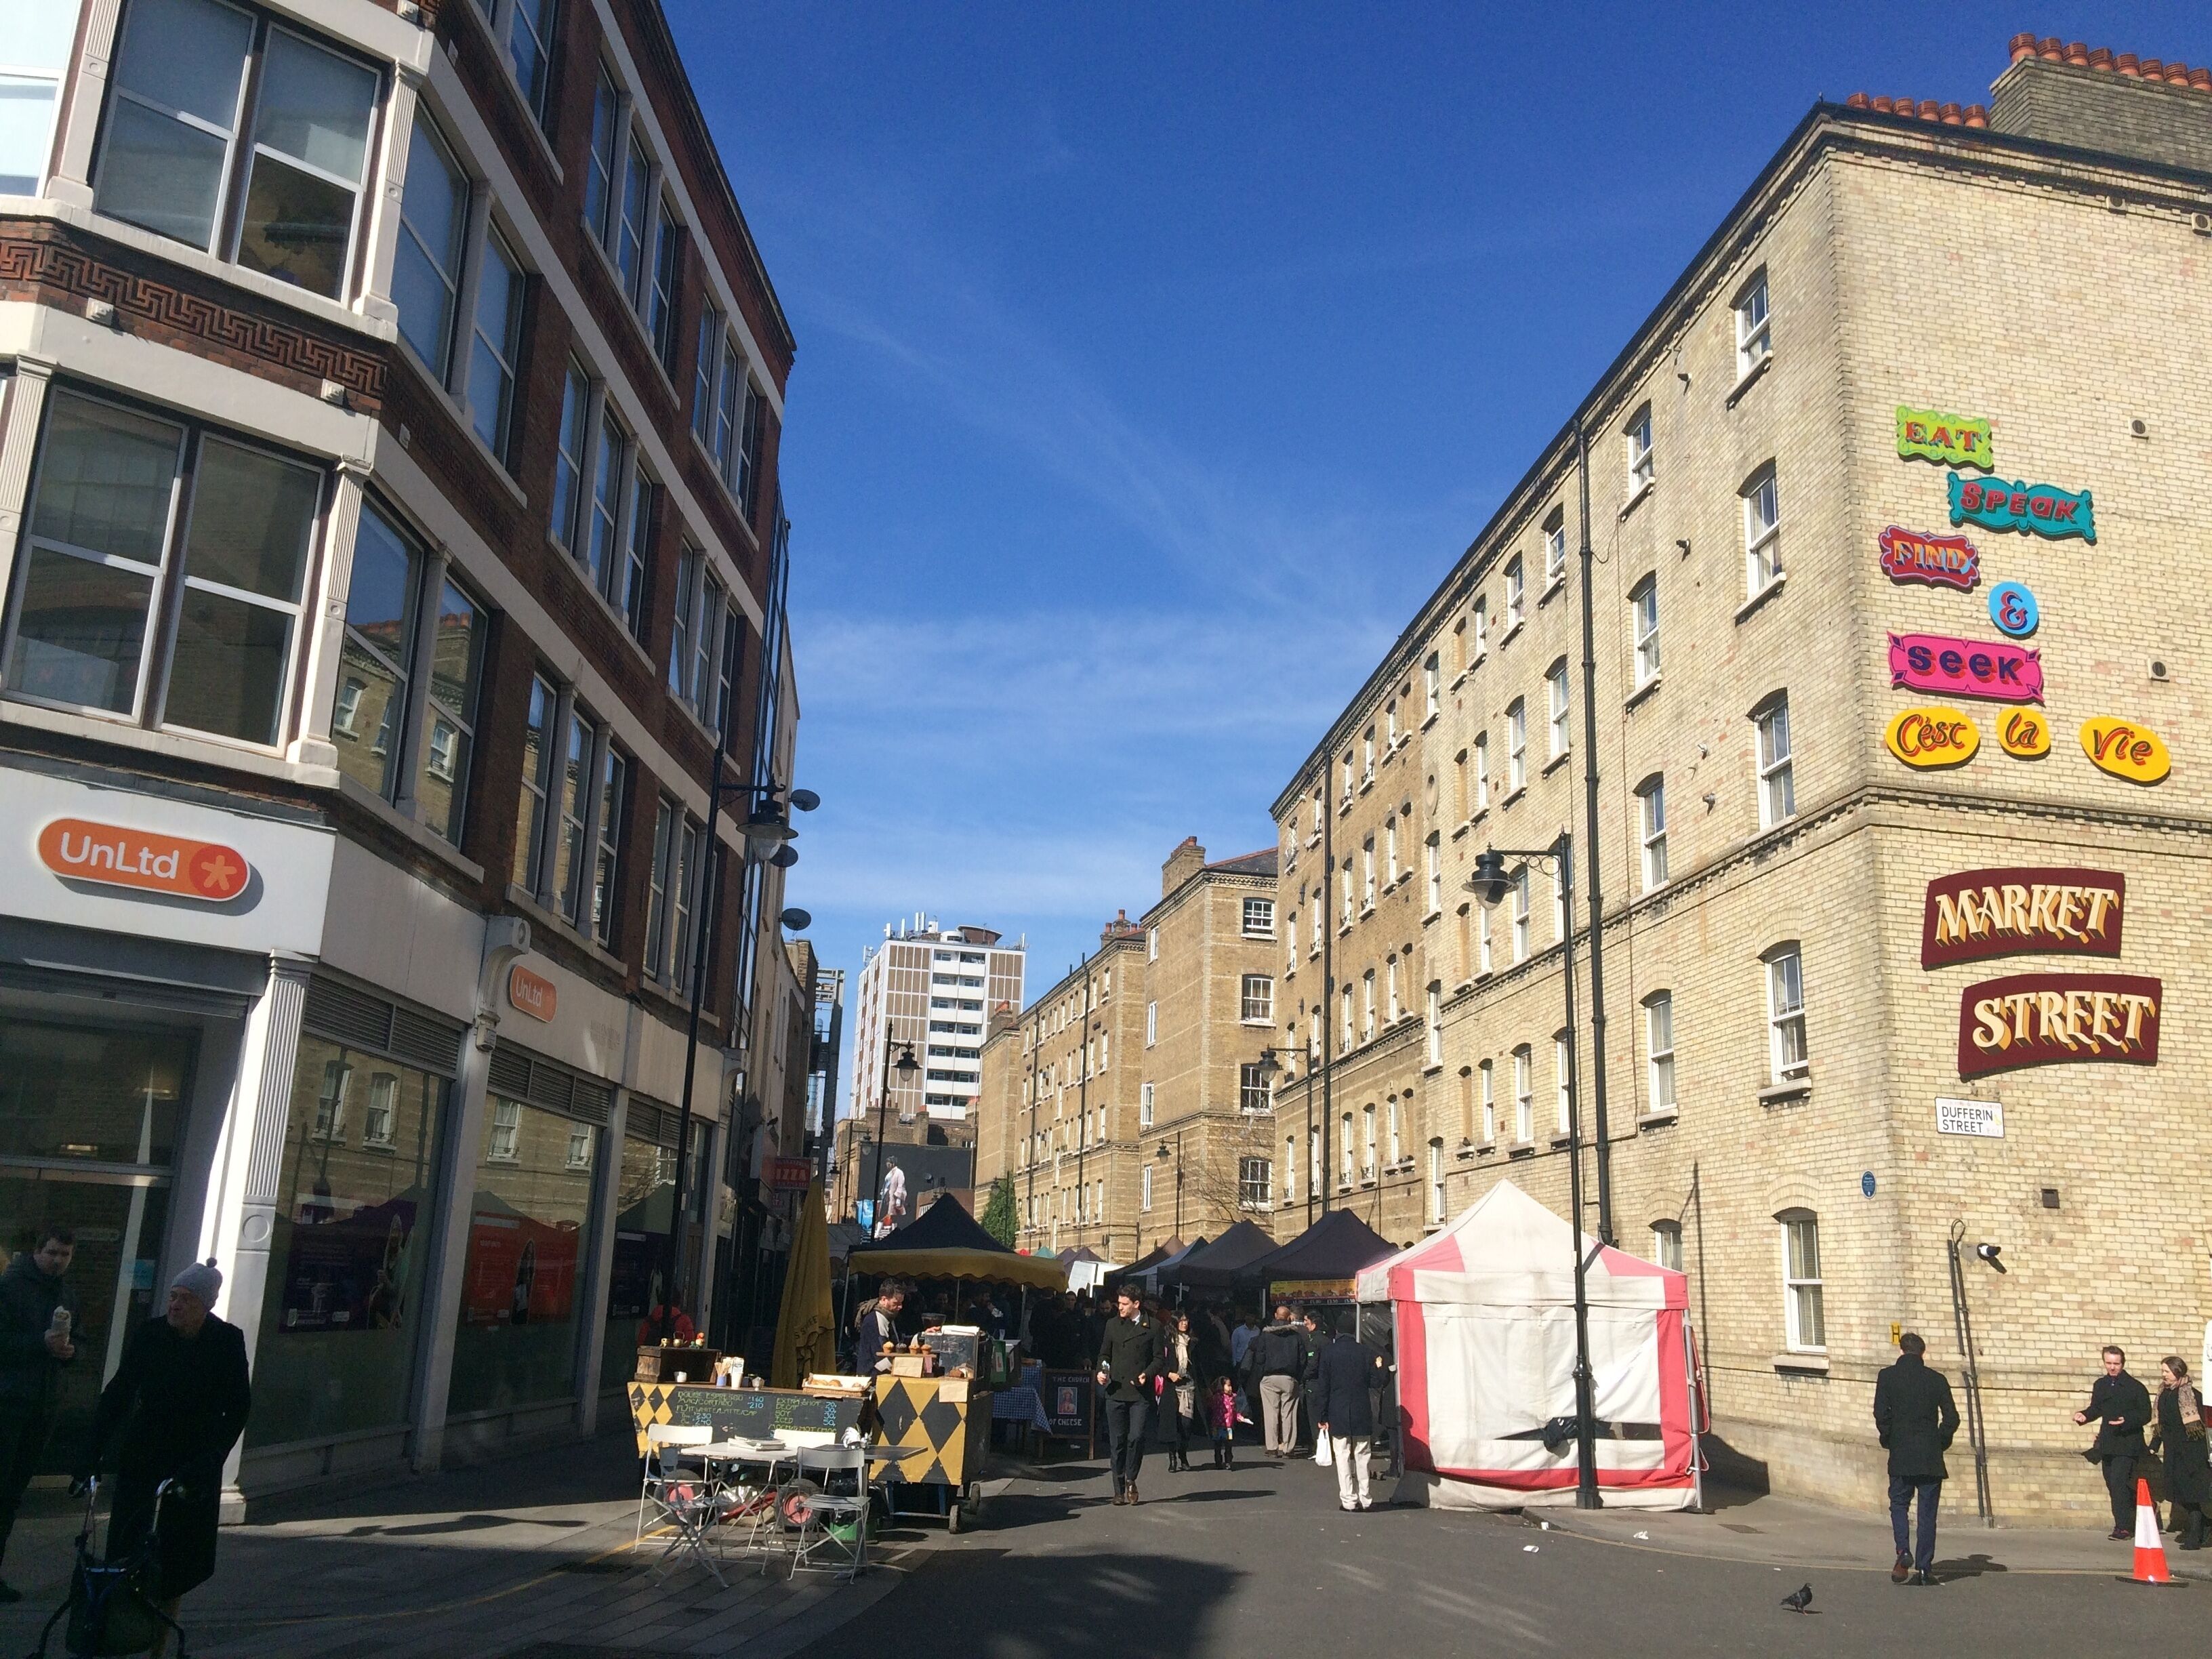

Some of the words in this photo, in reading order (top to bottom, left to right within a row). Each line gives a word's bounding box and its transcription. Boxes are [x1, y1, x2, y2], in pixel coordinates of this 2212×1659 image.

[1904, 421, 1982, 453] EAT
[1892, 539, 1971, 575] FIND
[2000, 590, 2029, 630] &
[60, 832, 180, 880] UnLtd
[1935, 884, 2119, 947] MARKET
[516, 975, 543, 1008] UnLtd
[1972, 990, 2156, 1054] STREET
[1942, 1106, 1993, 1121] DUFFERIN
[1942, 1119, 1984, 1133] STREET
[1892, 1325, 1900, 1343] H
